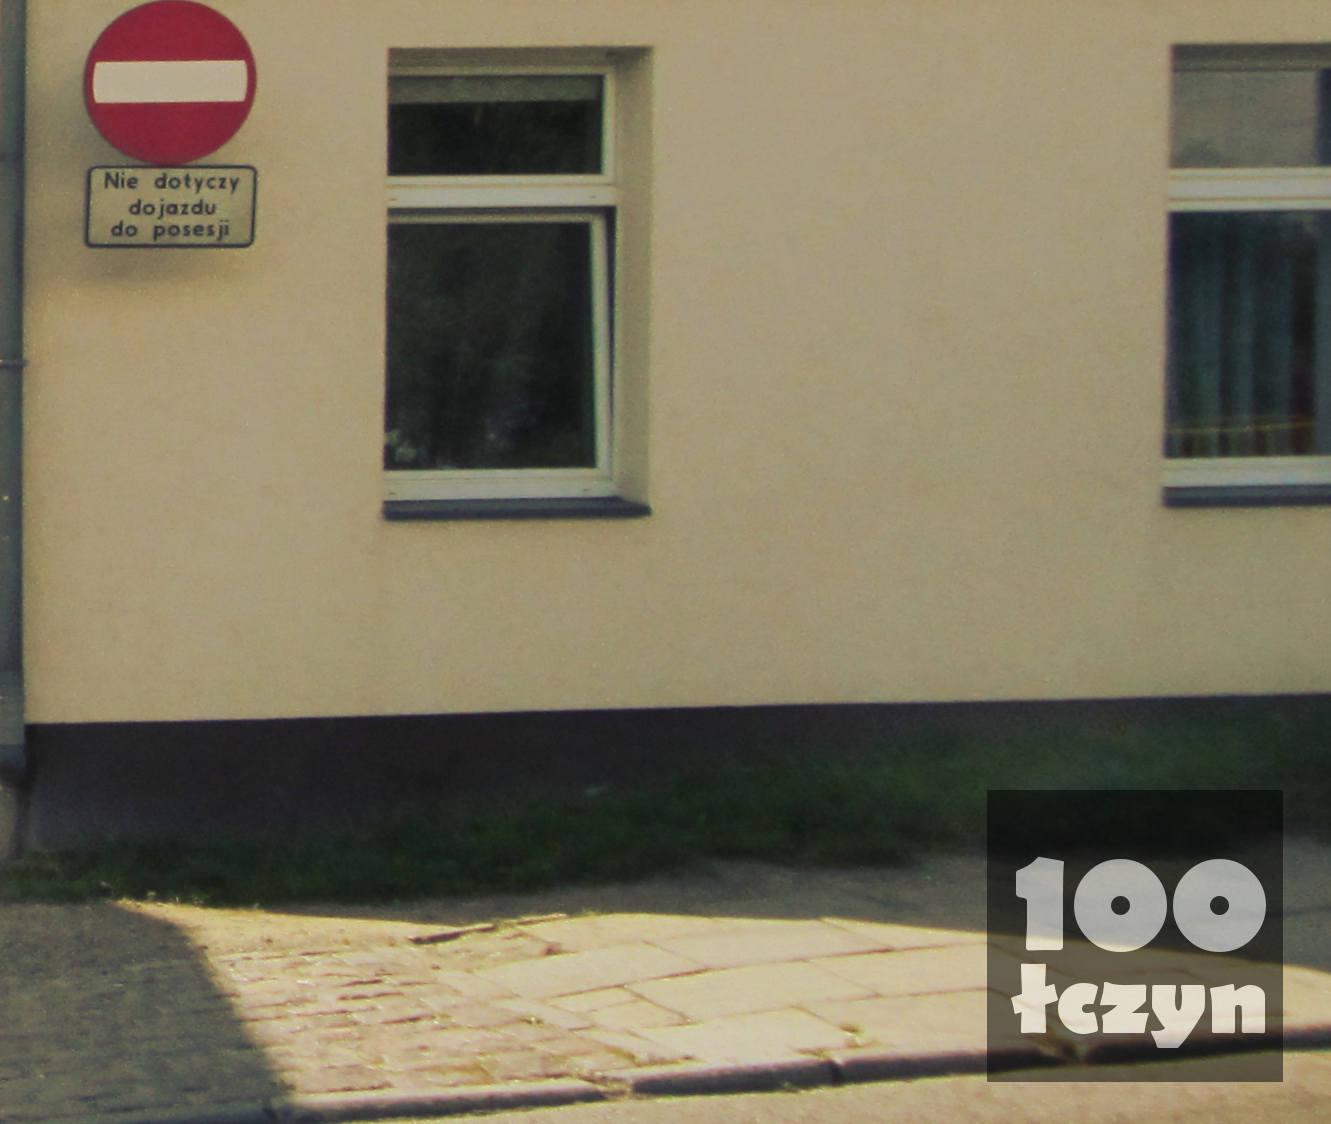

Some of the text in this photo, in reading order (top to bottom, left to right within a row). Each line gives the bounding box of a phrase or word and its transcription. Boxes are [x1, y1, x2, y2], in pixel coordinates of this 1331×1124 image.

[104, 172, 240, 194] Nie dotyczy
[129, 199, 217, 219] dojazdu
[110, 219, 230, 241] do posesji
